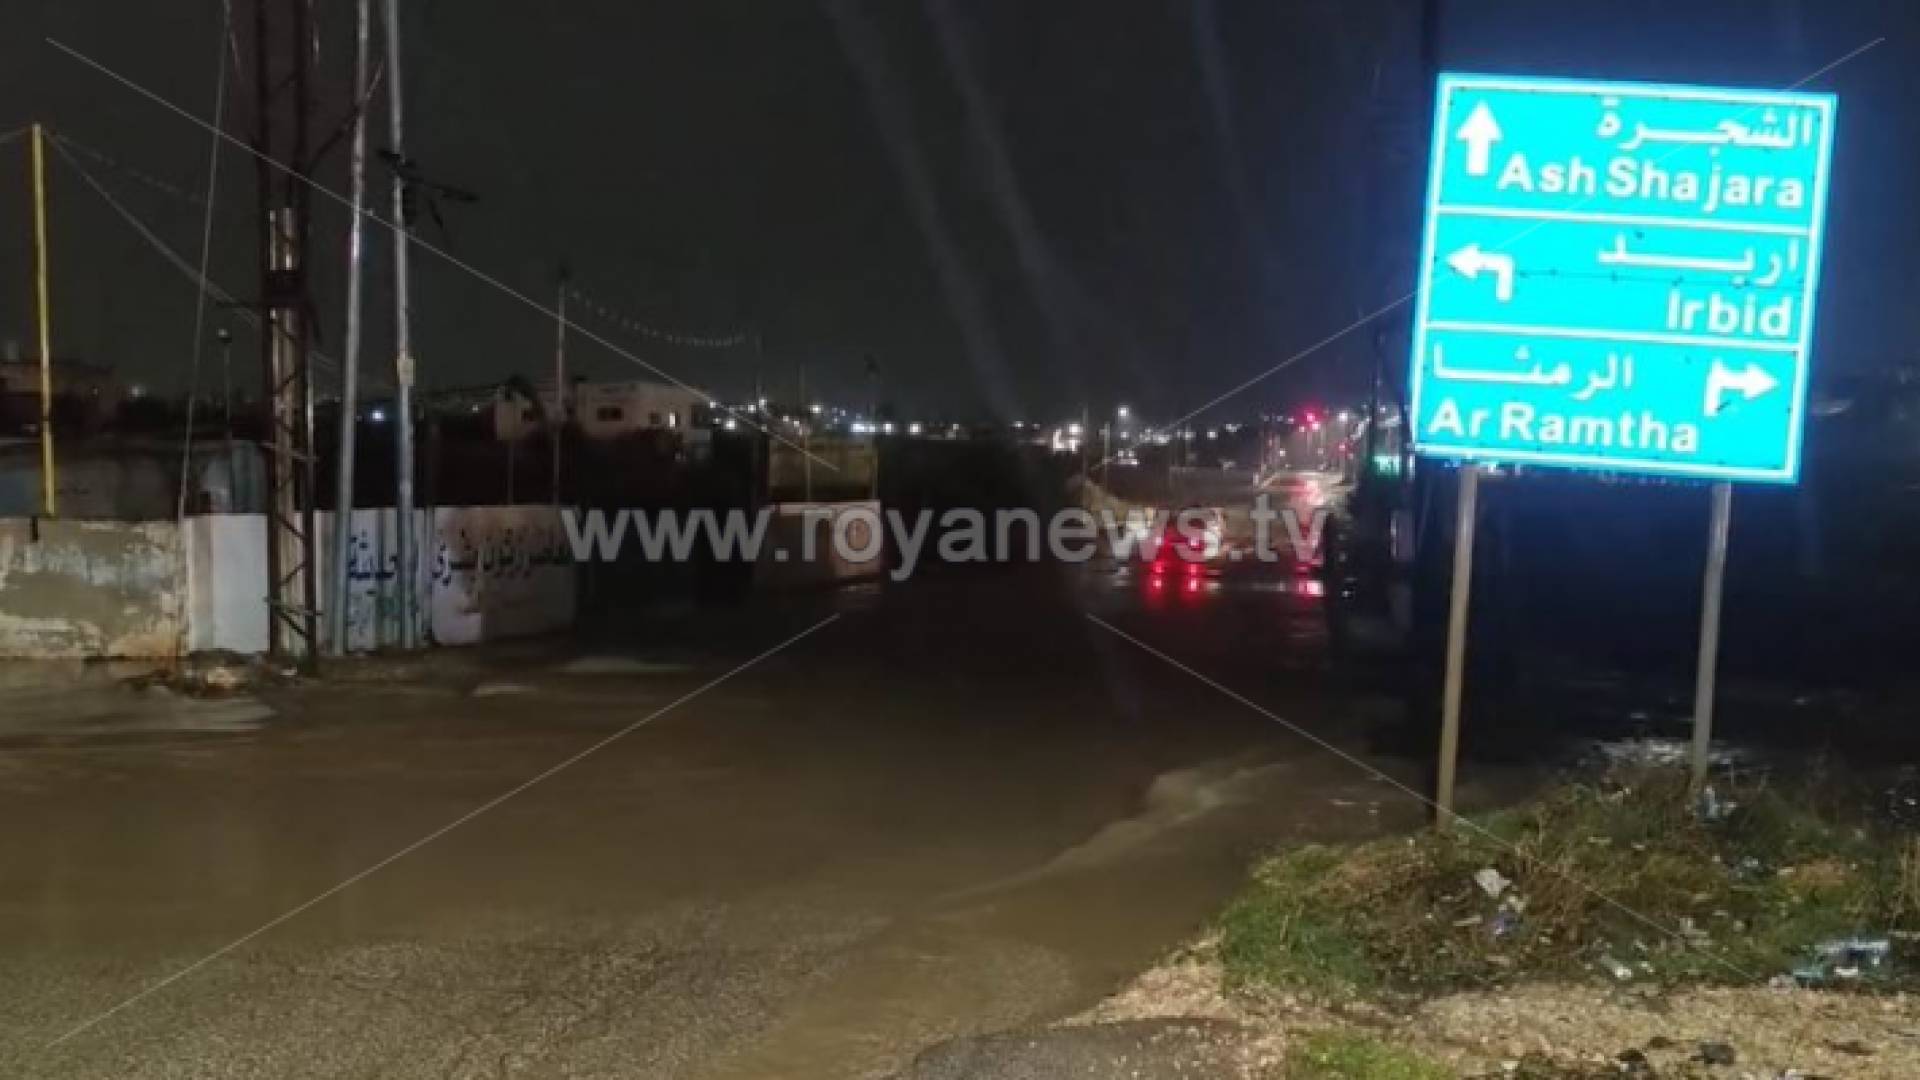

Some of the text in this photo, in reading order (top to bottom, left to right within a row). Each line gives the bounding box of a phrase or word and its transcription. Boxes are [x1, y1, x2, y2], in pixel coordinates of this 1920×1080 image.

[1596, 96, 1813, 150] الشجرة
[1498, 147, 1804, 213] Ash Shajara
[1597, 233, 1799, 288] اربد
[1665, 290, 1793, 337] Irbid
[1432, 342, 1634, 401] الرمثا
[1427, 399, 1699, 453] Ar Ramtha
